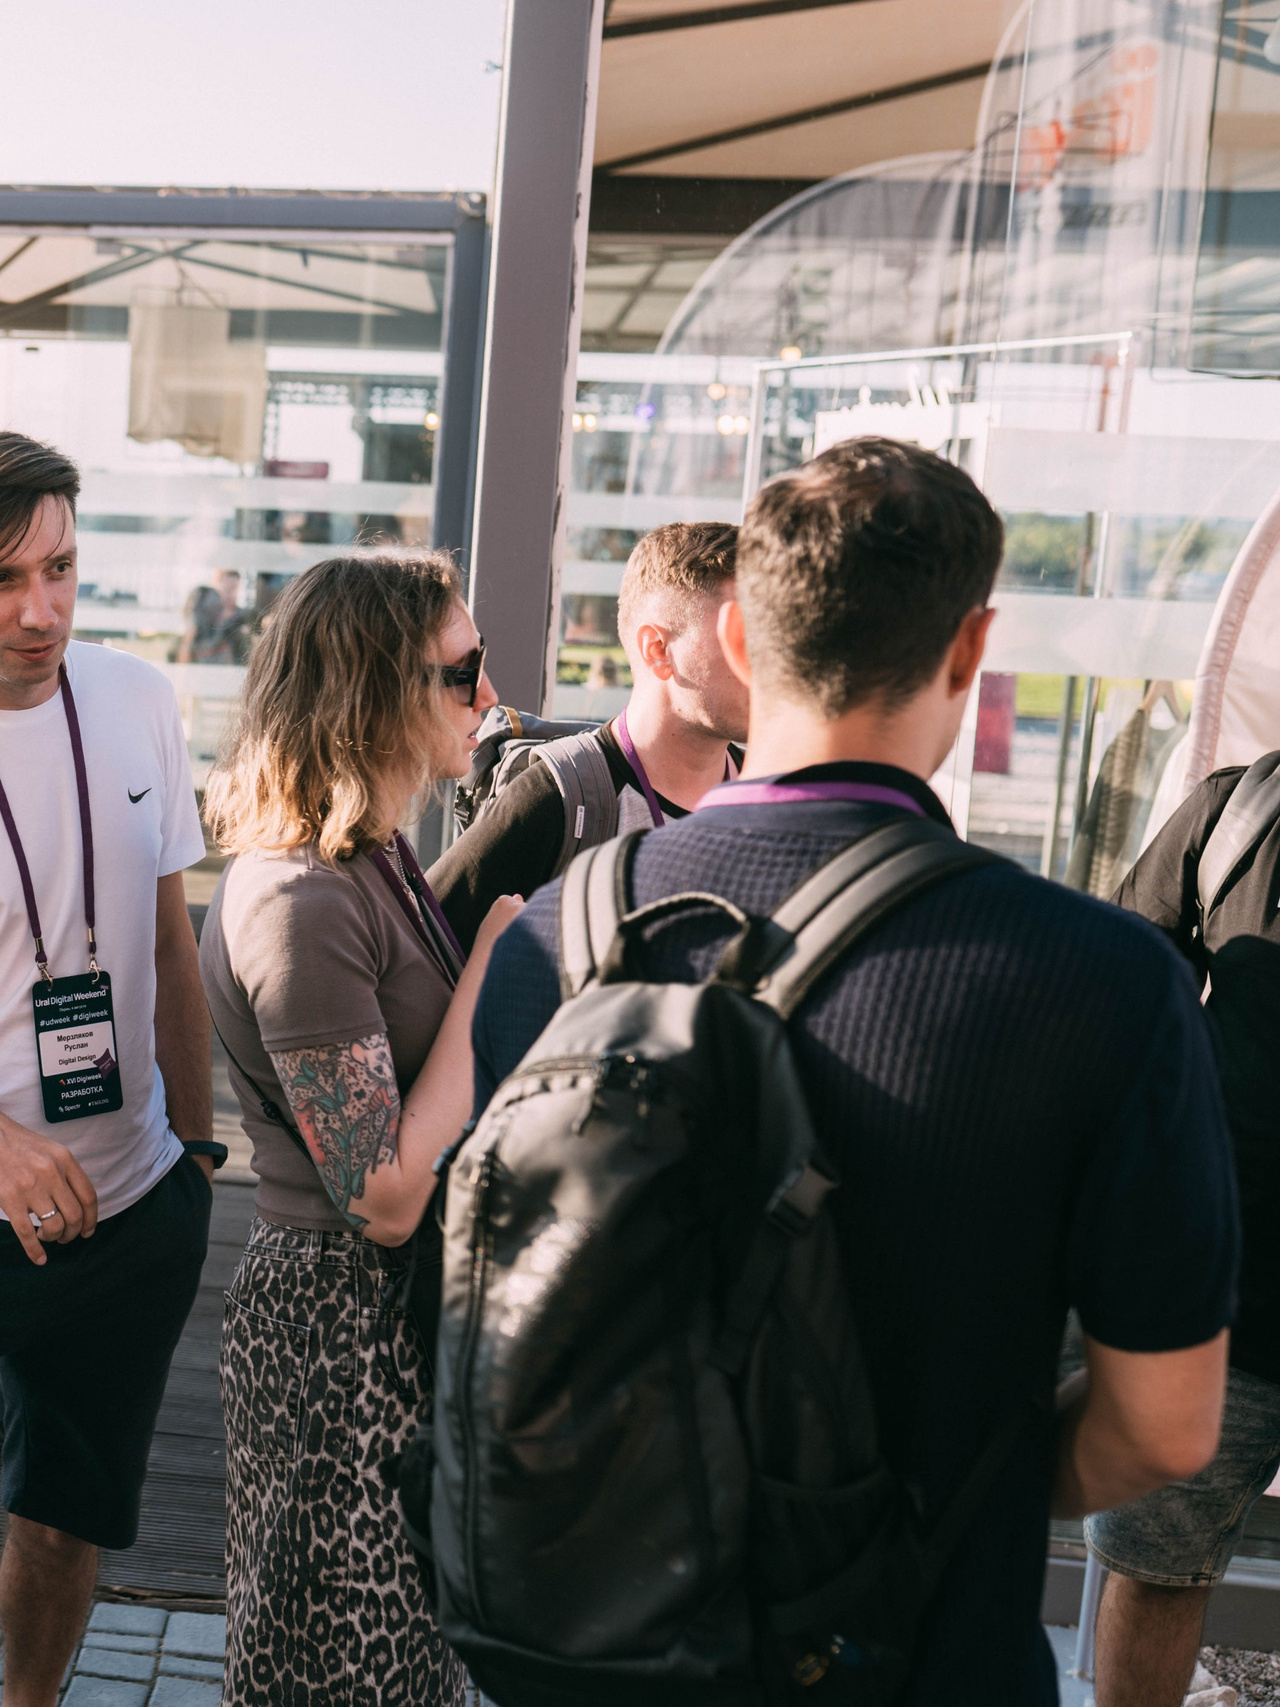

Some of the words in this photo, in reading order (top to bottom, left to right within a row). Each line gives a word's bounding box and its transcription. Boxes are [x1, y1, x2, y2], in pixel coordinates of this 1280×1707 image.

[35, 997, 50, 1007] Ural
[51, 994, 74, 1006] Digital
[74, 989, 106, 1001] Weekend
[40, 1016, 70, 1026] #udweek
[73, 1009, 108, 1021] #digiweek
[64, 1042, 89, 1052] Руслан
[58, 1056, 76, 1065] Digital
[77, 1054, 96, 1062] Design
[77, 1073, 102, 1083] Digiweek
[61, 1085, 104, 1100] РАЗРАБОТКА
